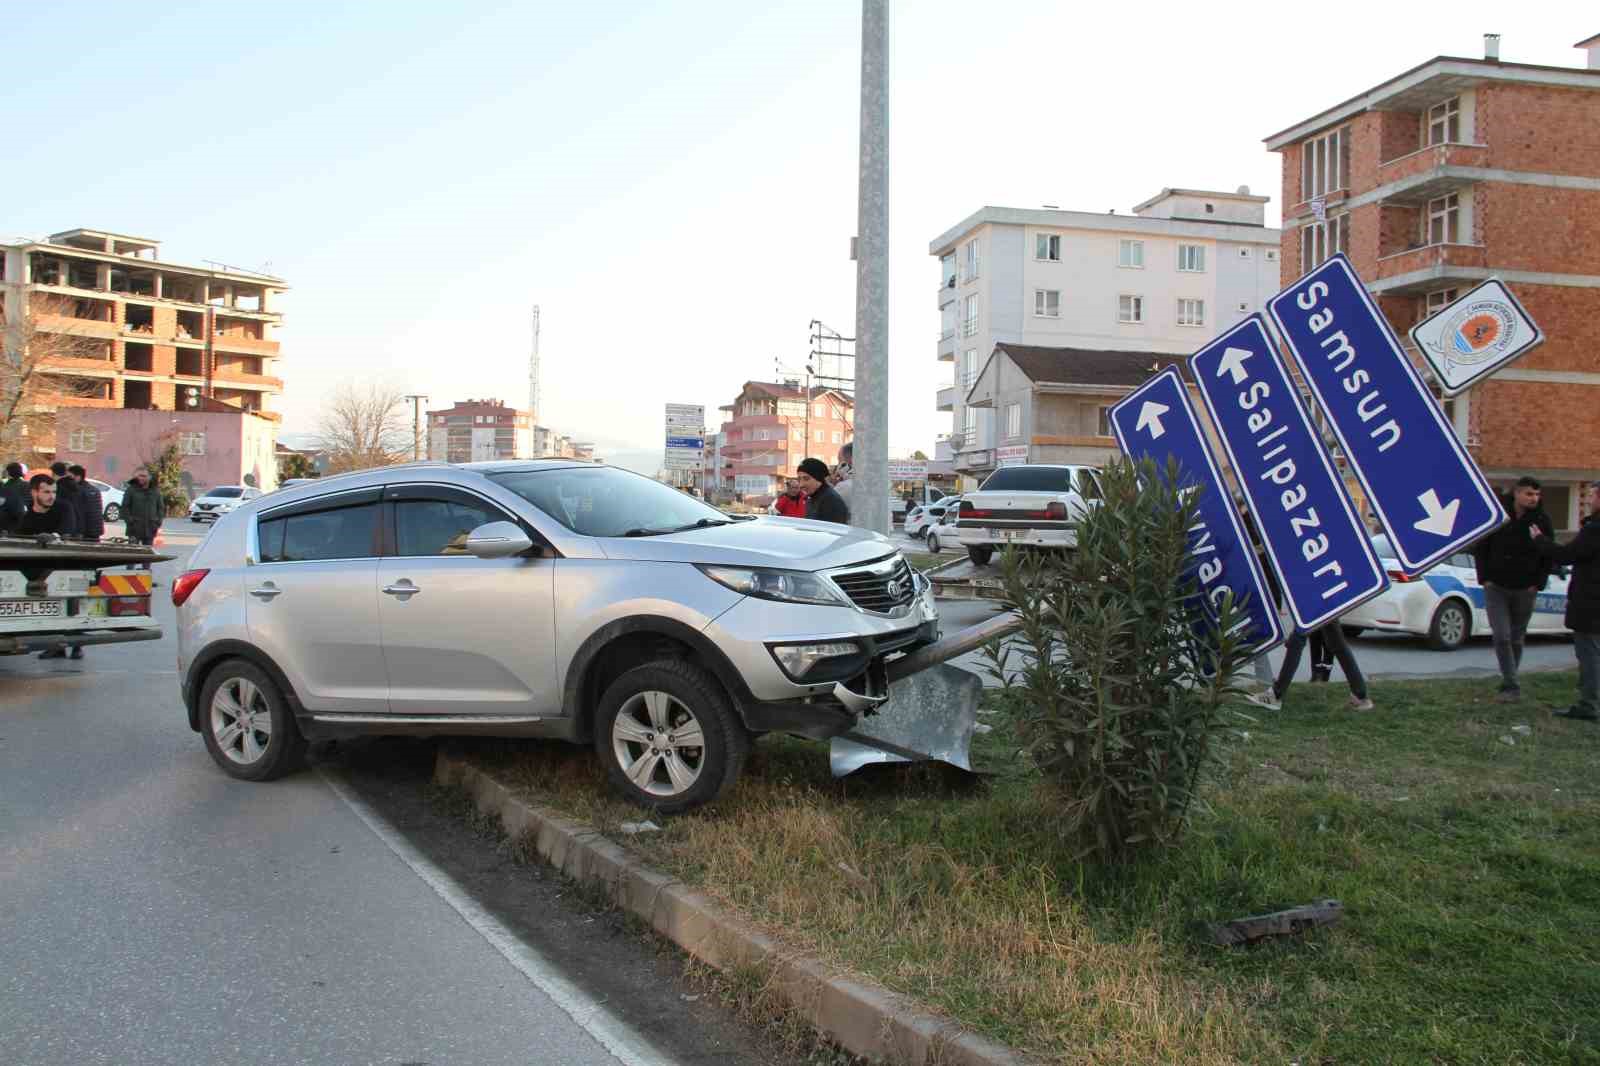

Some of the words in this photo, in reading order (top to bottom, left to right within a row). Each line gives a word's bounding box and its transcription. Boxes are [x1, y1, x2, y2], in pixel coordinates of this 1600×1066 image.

[1297, 280, 1402, 452] Samsun
[1239, 381, 1348, 599] Salıpazarı
[0, 602, 58, 615] 55AFL555
